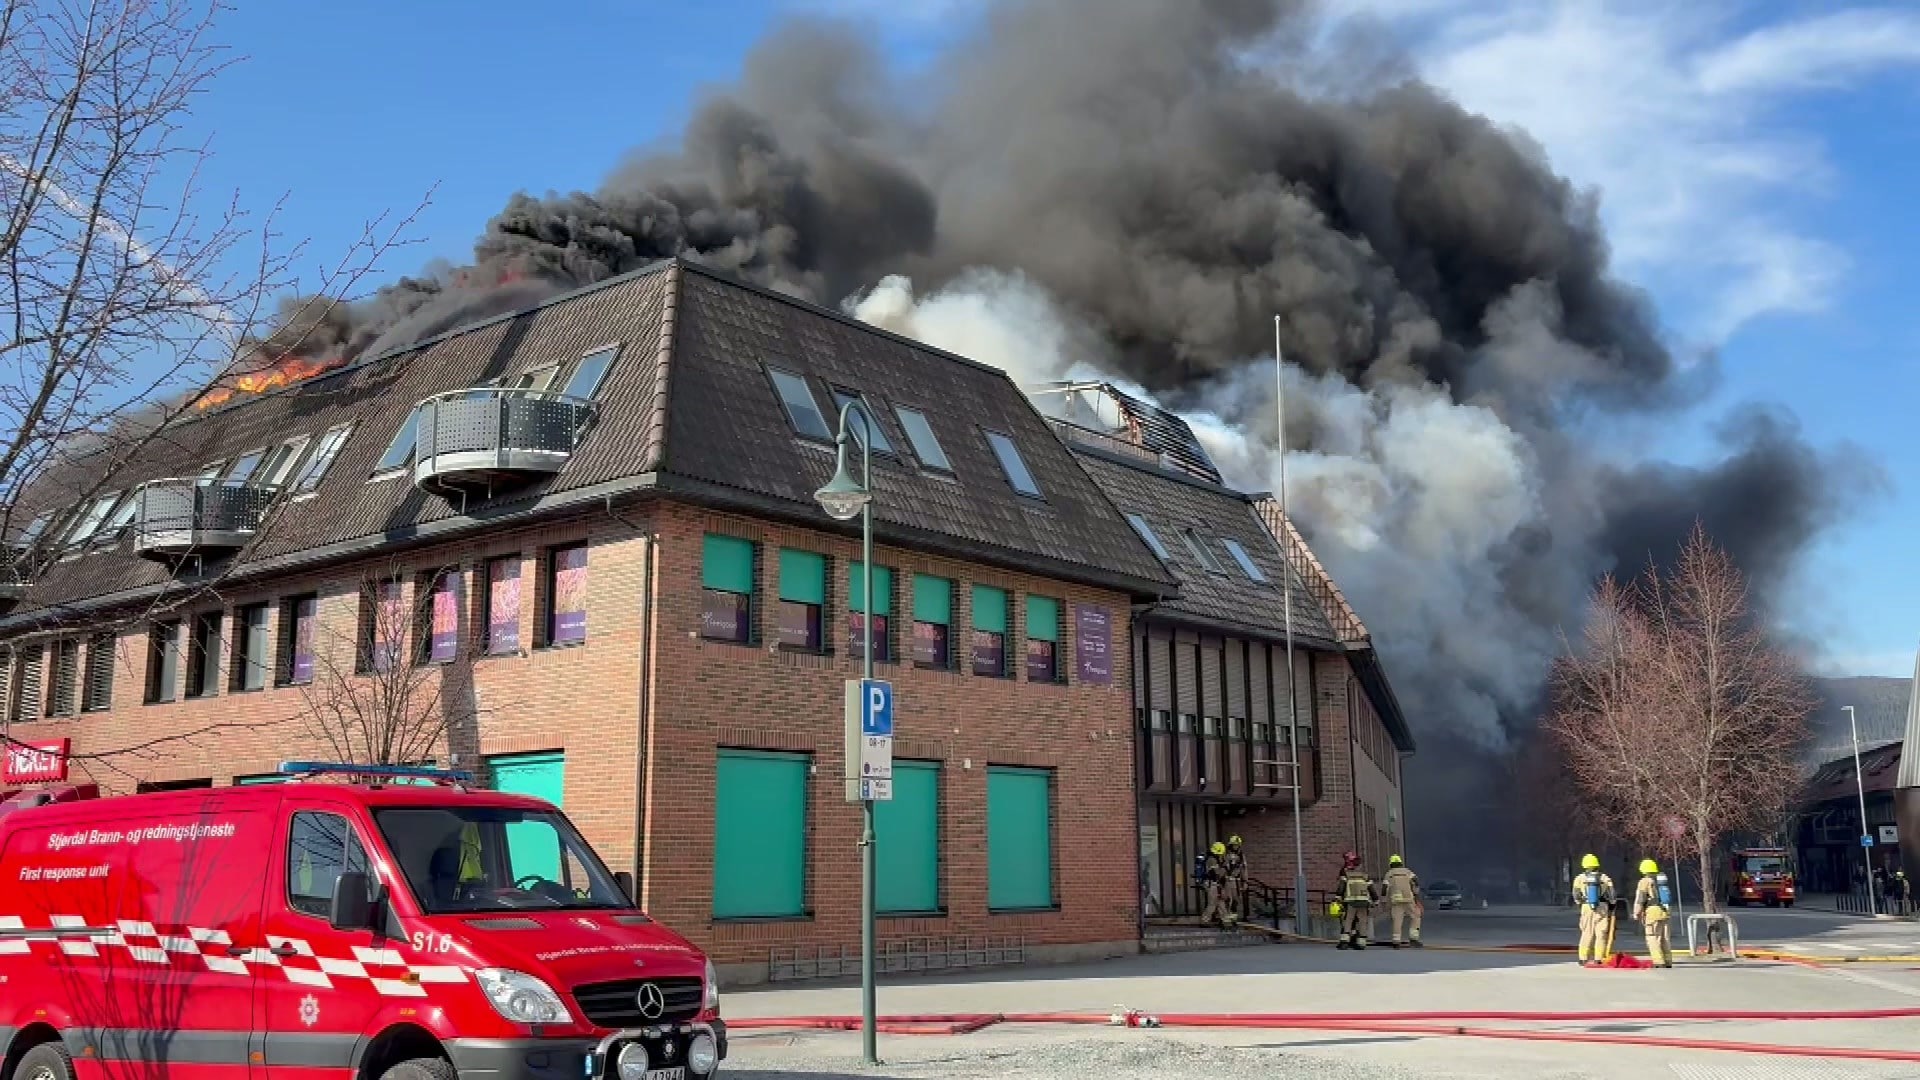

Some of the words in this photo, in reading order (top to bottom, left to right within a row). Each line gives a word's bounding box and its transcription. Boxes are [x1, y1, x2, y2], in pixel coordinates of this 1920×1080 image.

[869, 687, 886, 727] P
[8, 745, 60, 775] TICKET
[89, 829, 125, 845] Brann-
[126, 828, 142, 846] og
[142, 822, 236, 842] redningstjeneste
[19, 866, 42, 881] First
[42, 866, 87, 882] response
[88, 863, 110, 877] unit
[412, 931, 453, 953] S1.6
